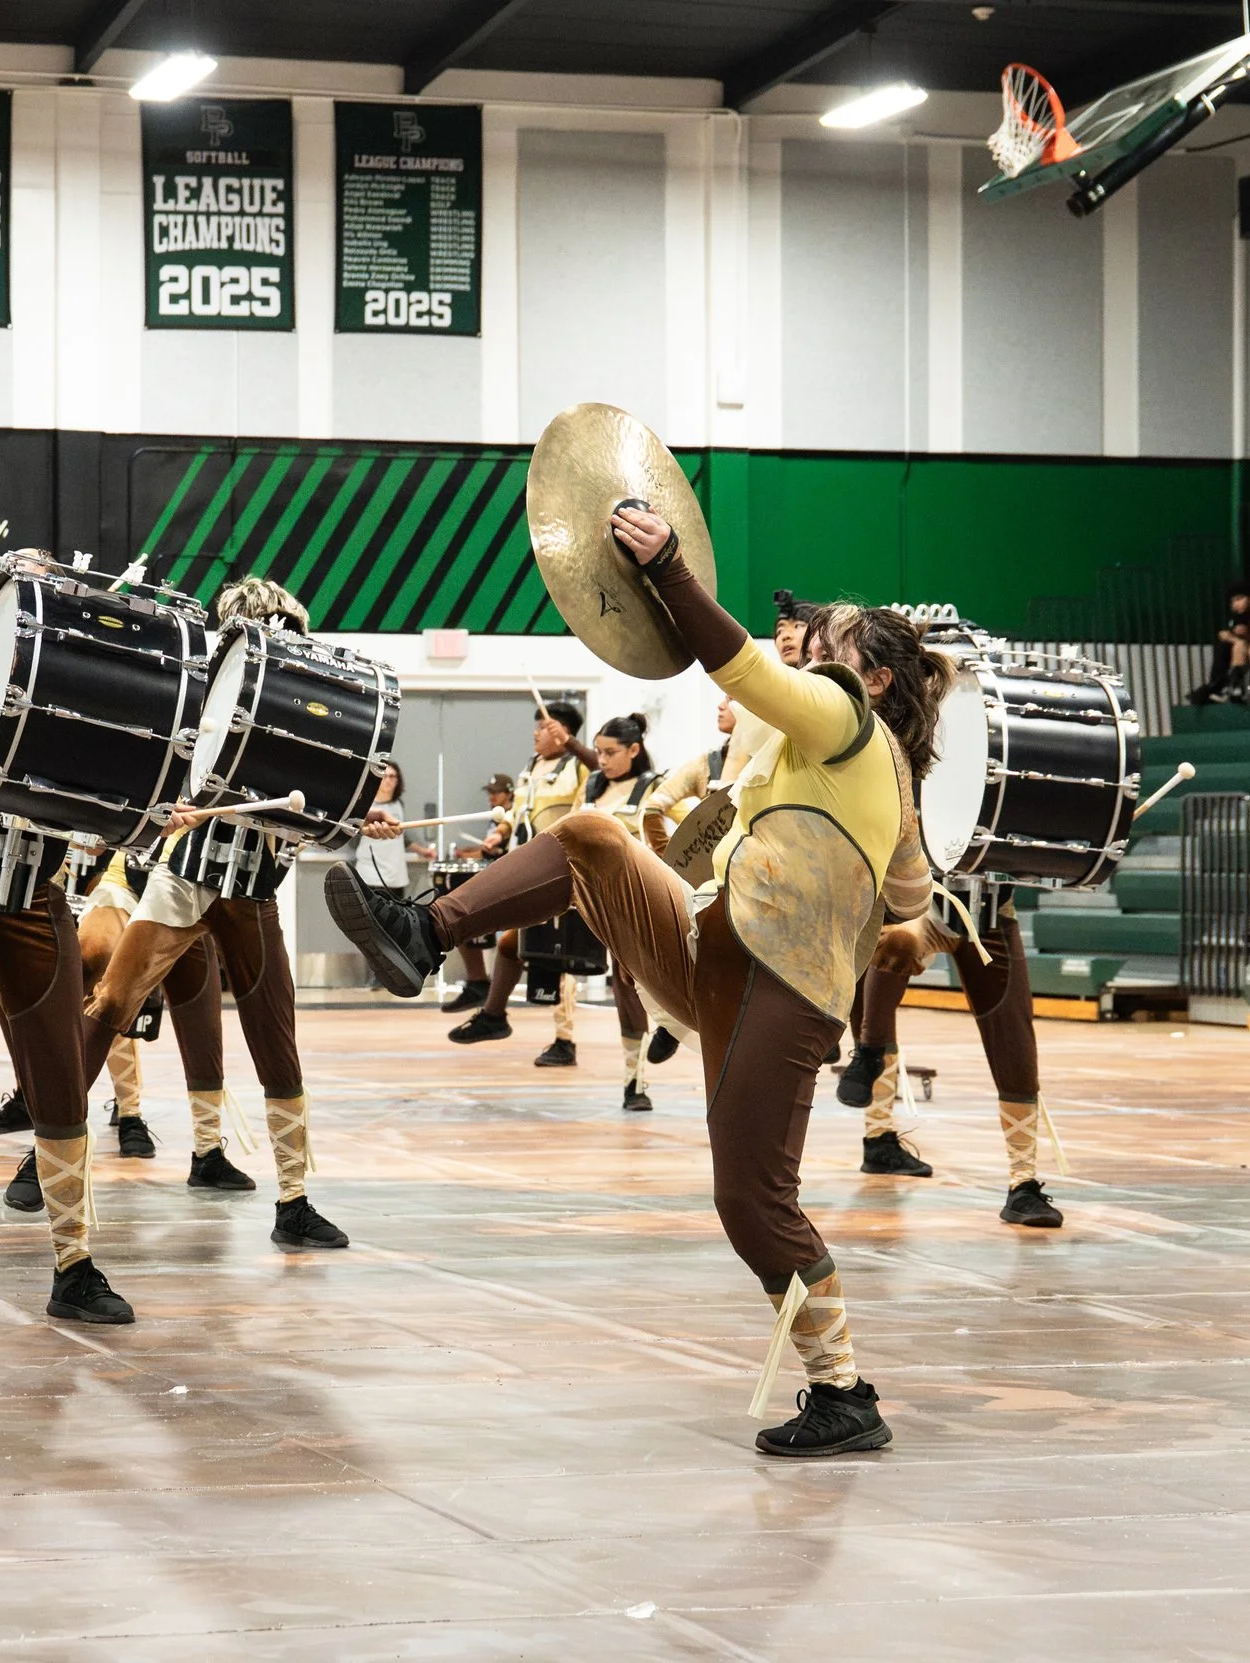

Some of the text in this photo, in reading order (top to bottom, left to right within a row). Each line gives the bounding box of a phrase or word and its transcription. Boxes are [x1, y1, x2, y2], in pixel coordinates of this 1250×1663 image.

[186, 150, 249, 165] SOFTBALL
[354, 154, 464, 172] LEAGUE CHAMPIONS
[153, 175, 285, 214] LEAGUE
[153, 213, 285, 257] CHAMPIONS
[159, 264, 281, 317] 2025
[364, 290, 452, 327] 2025
[303, 649, 355, 674] YAMAHA
